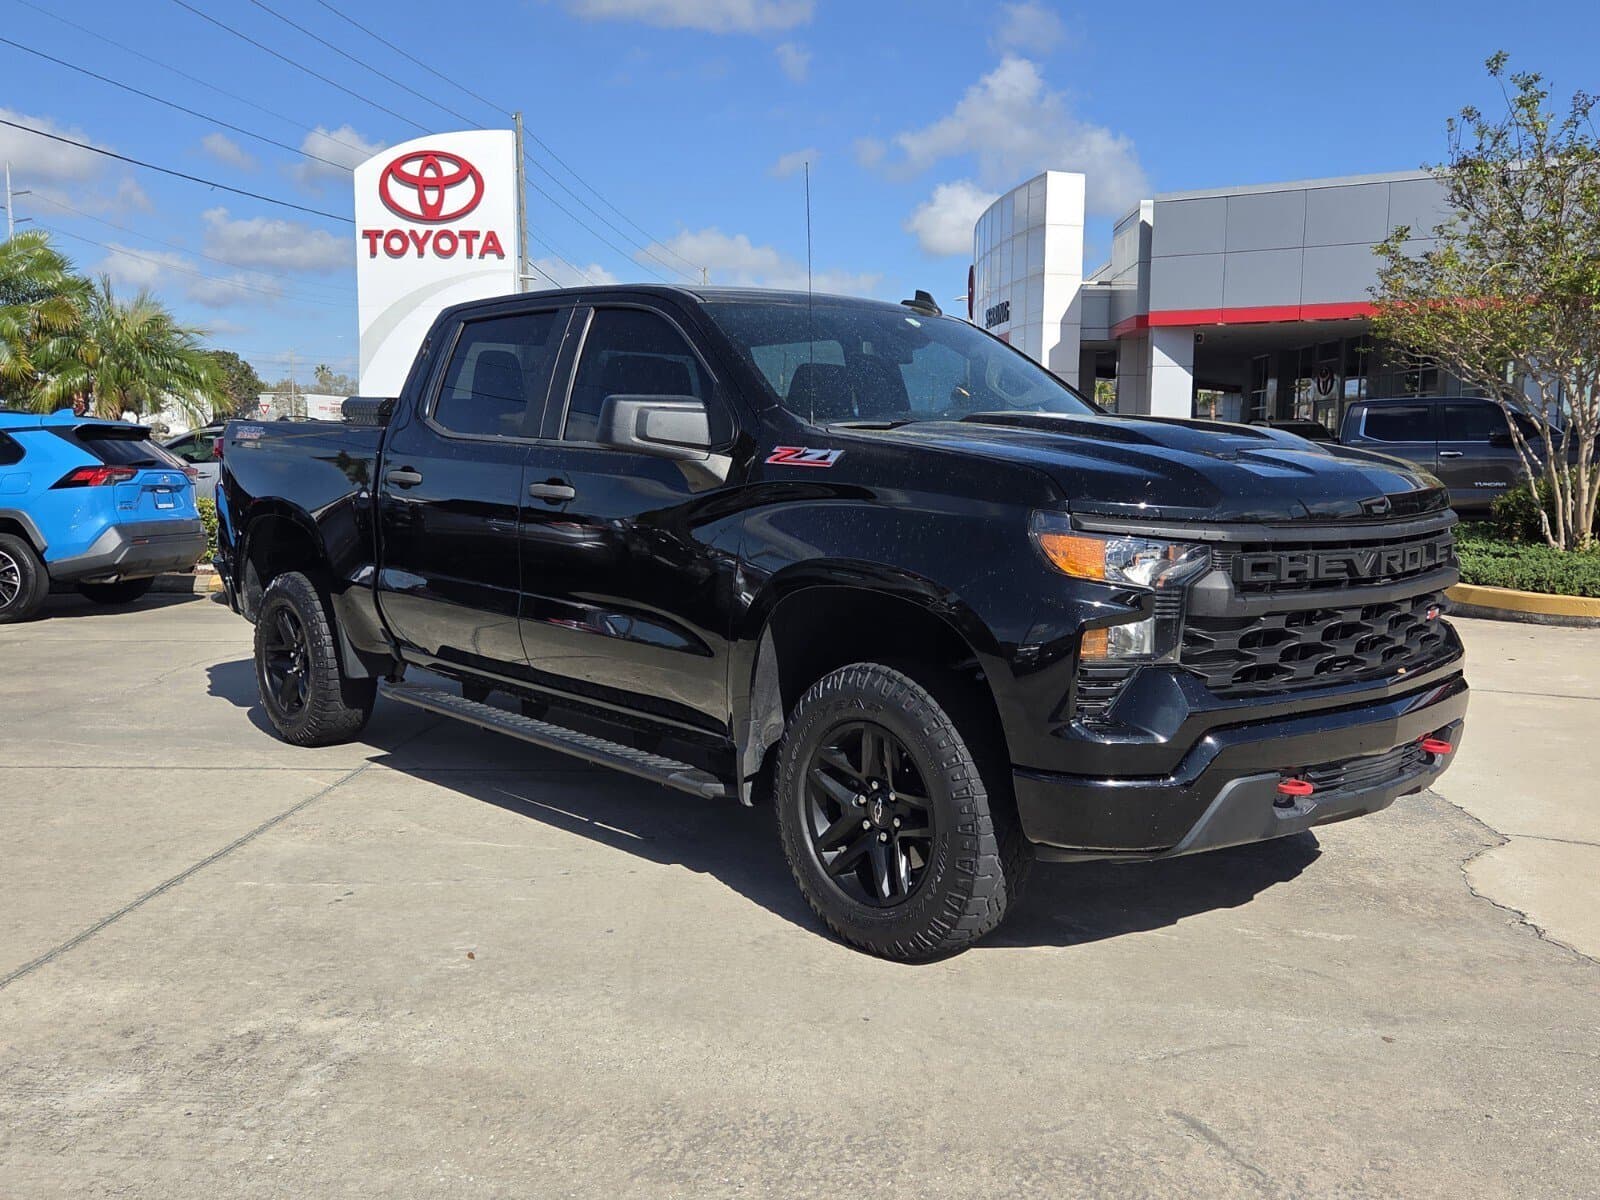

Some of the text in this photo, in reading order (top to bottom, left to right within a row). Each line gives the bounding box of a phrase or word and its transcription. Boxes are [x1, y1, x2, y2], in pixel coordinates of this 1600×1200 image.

[362, 229, 505, 259] TOYOTA
[765, 446, 845, 467] Z71
[1236, 541, 1453, 583] CHEVROLE
